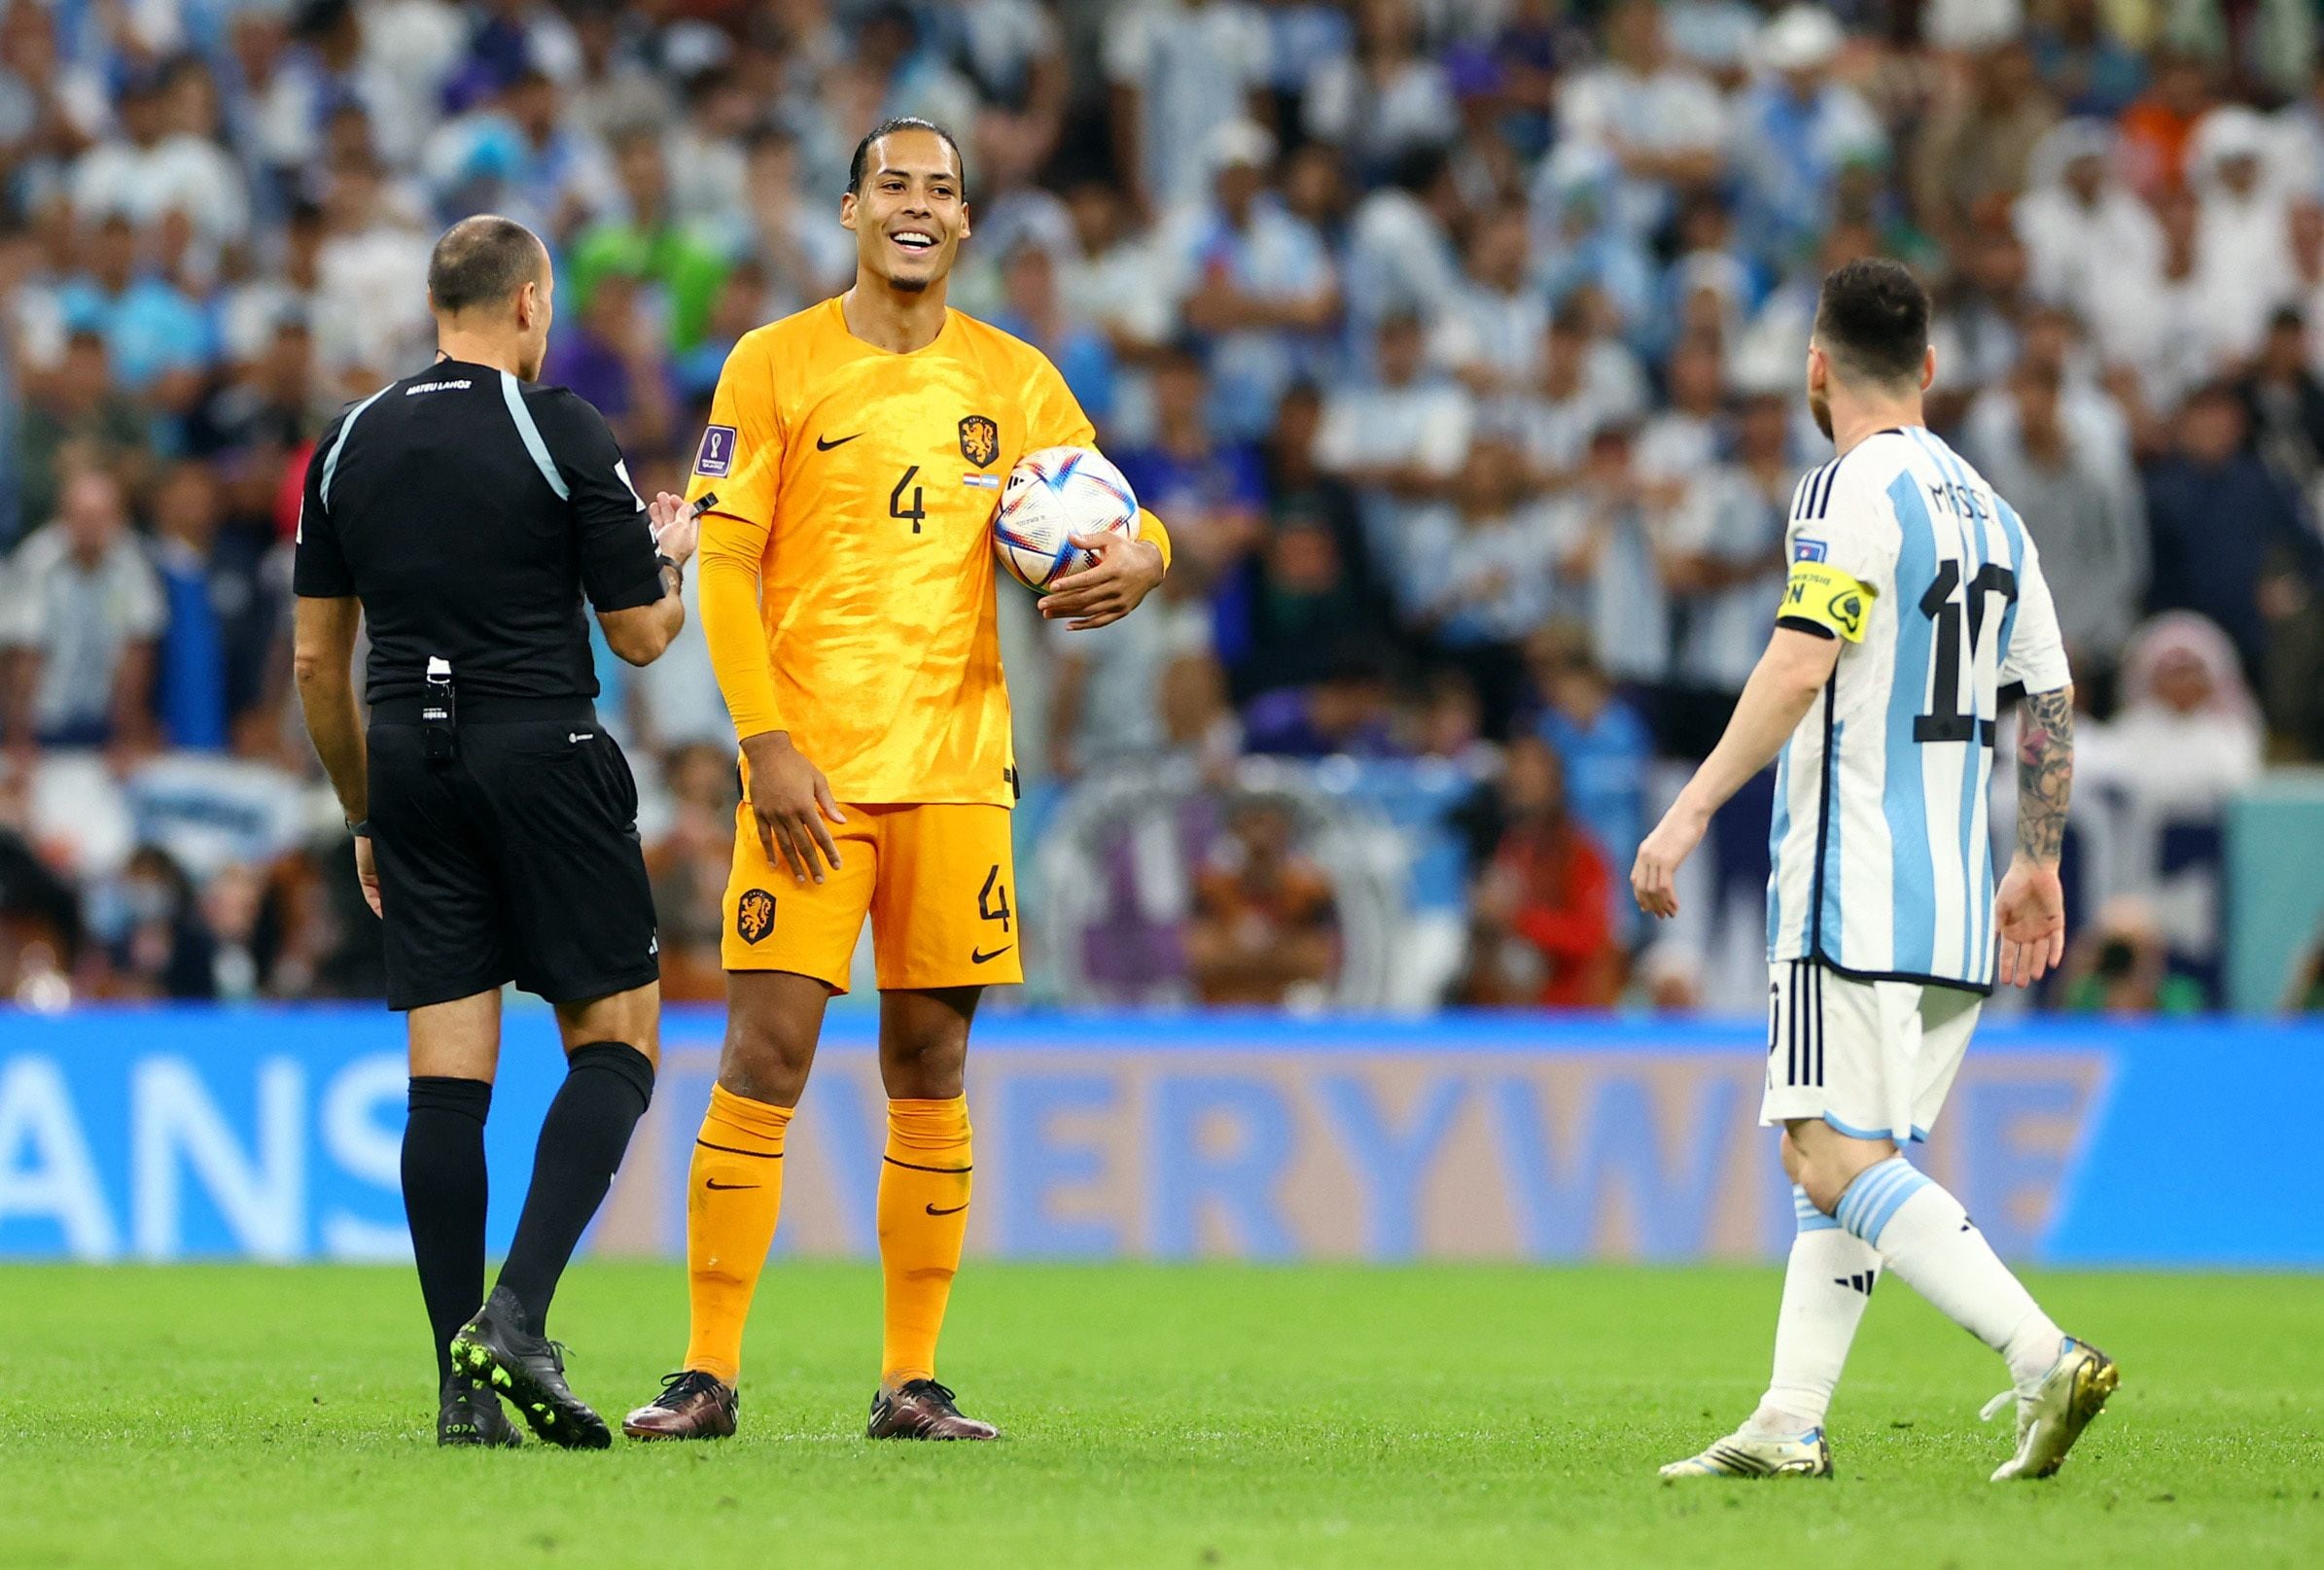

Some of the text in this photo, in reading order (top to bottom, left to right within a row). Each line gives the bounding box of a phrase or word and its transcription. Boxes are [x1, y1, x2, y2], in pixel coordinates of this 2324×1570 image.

[890, 466, 926, 534] 4
[1927, 481, 1994, 525] MESS
[1913, 558, 2019, 748] 10
[978, 864, 1010, 932] 4
[445, 1423, 477, 1434] COPA
